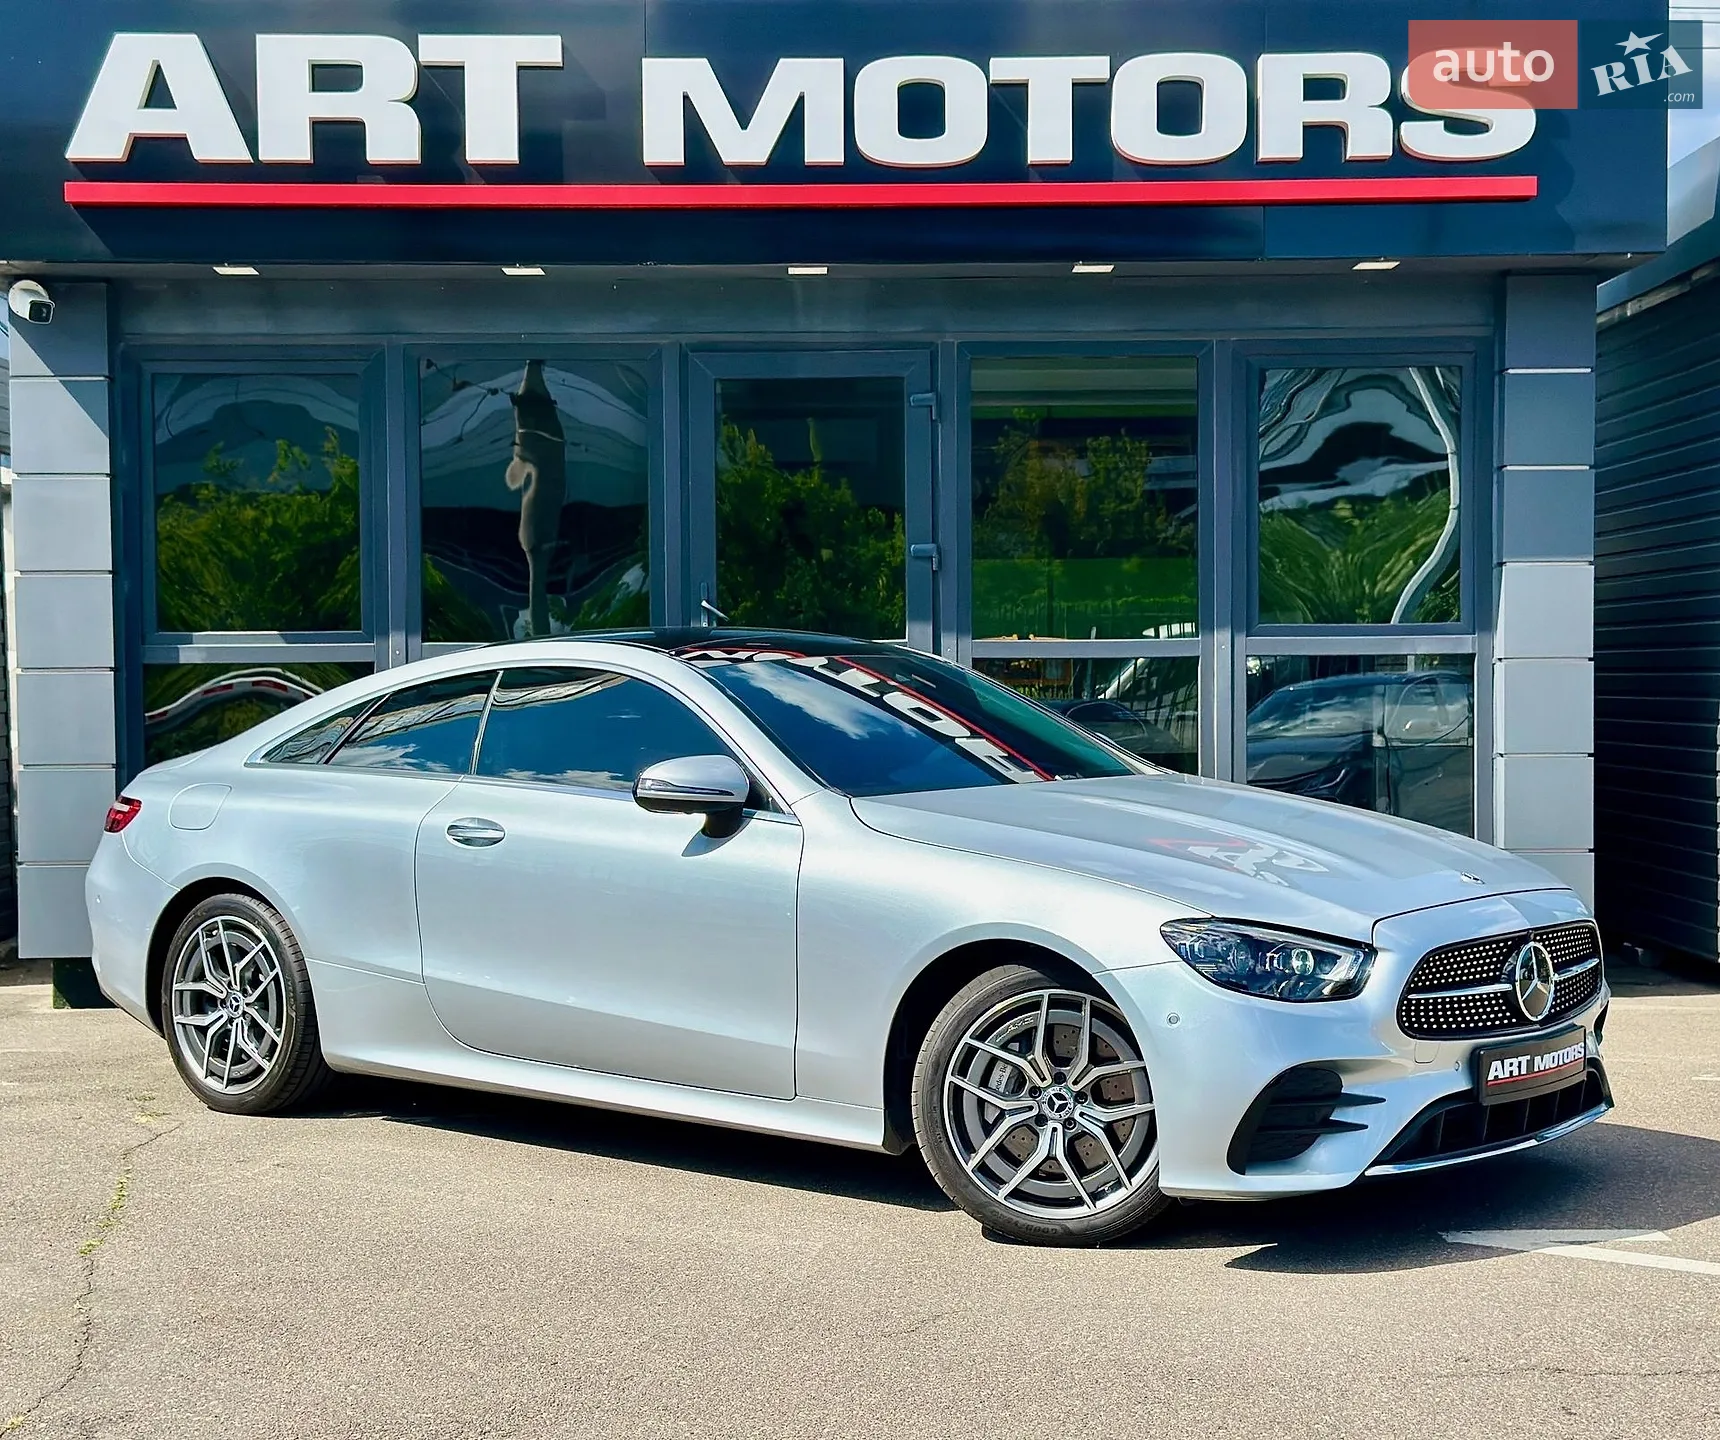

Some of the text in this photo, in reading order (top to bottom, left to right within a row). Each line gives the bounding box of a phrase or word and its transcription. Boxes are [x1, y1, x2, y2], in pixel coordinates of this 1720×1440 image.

[65, 31, 1537, 168] ART MOTORS
[1487, 1042, 1584, 1080] ART MOTORS
